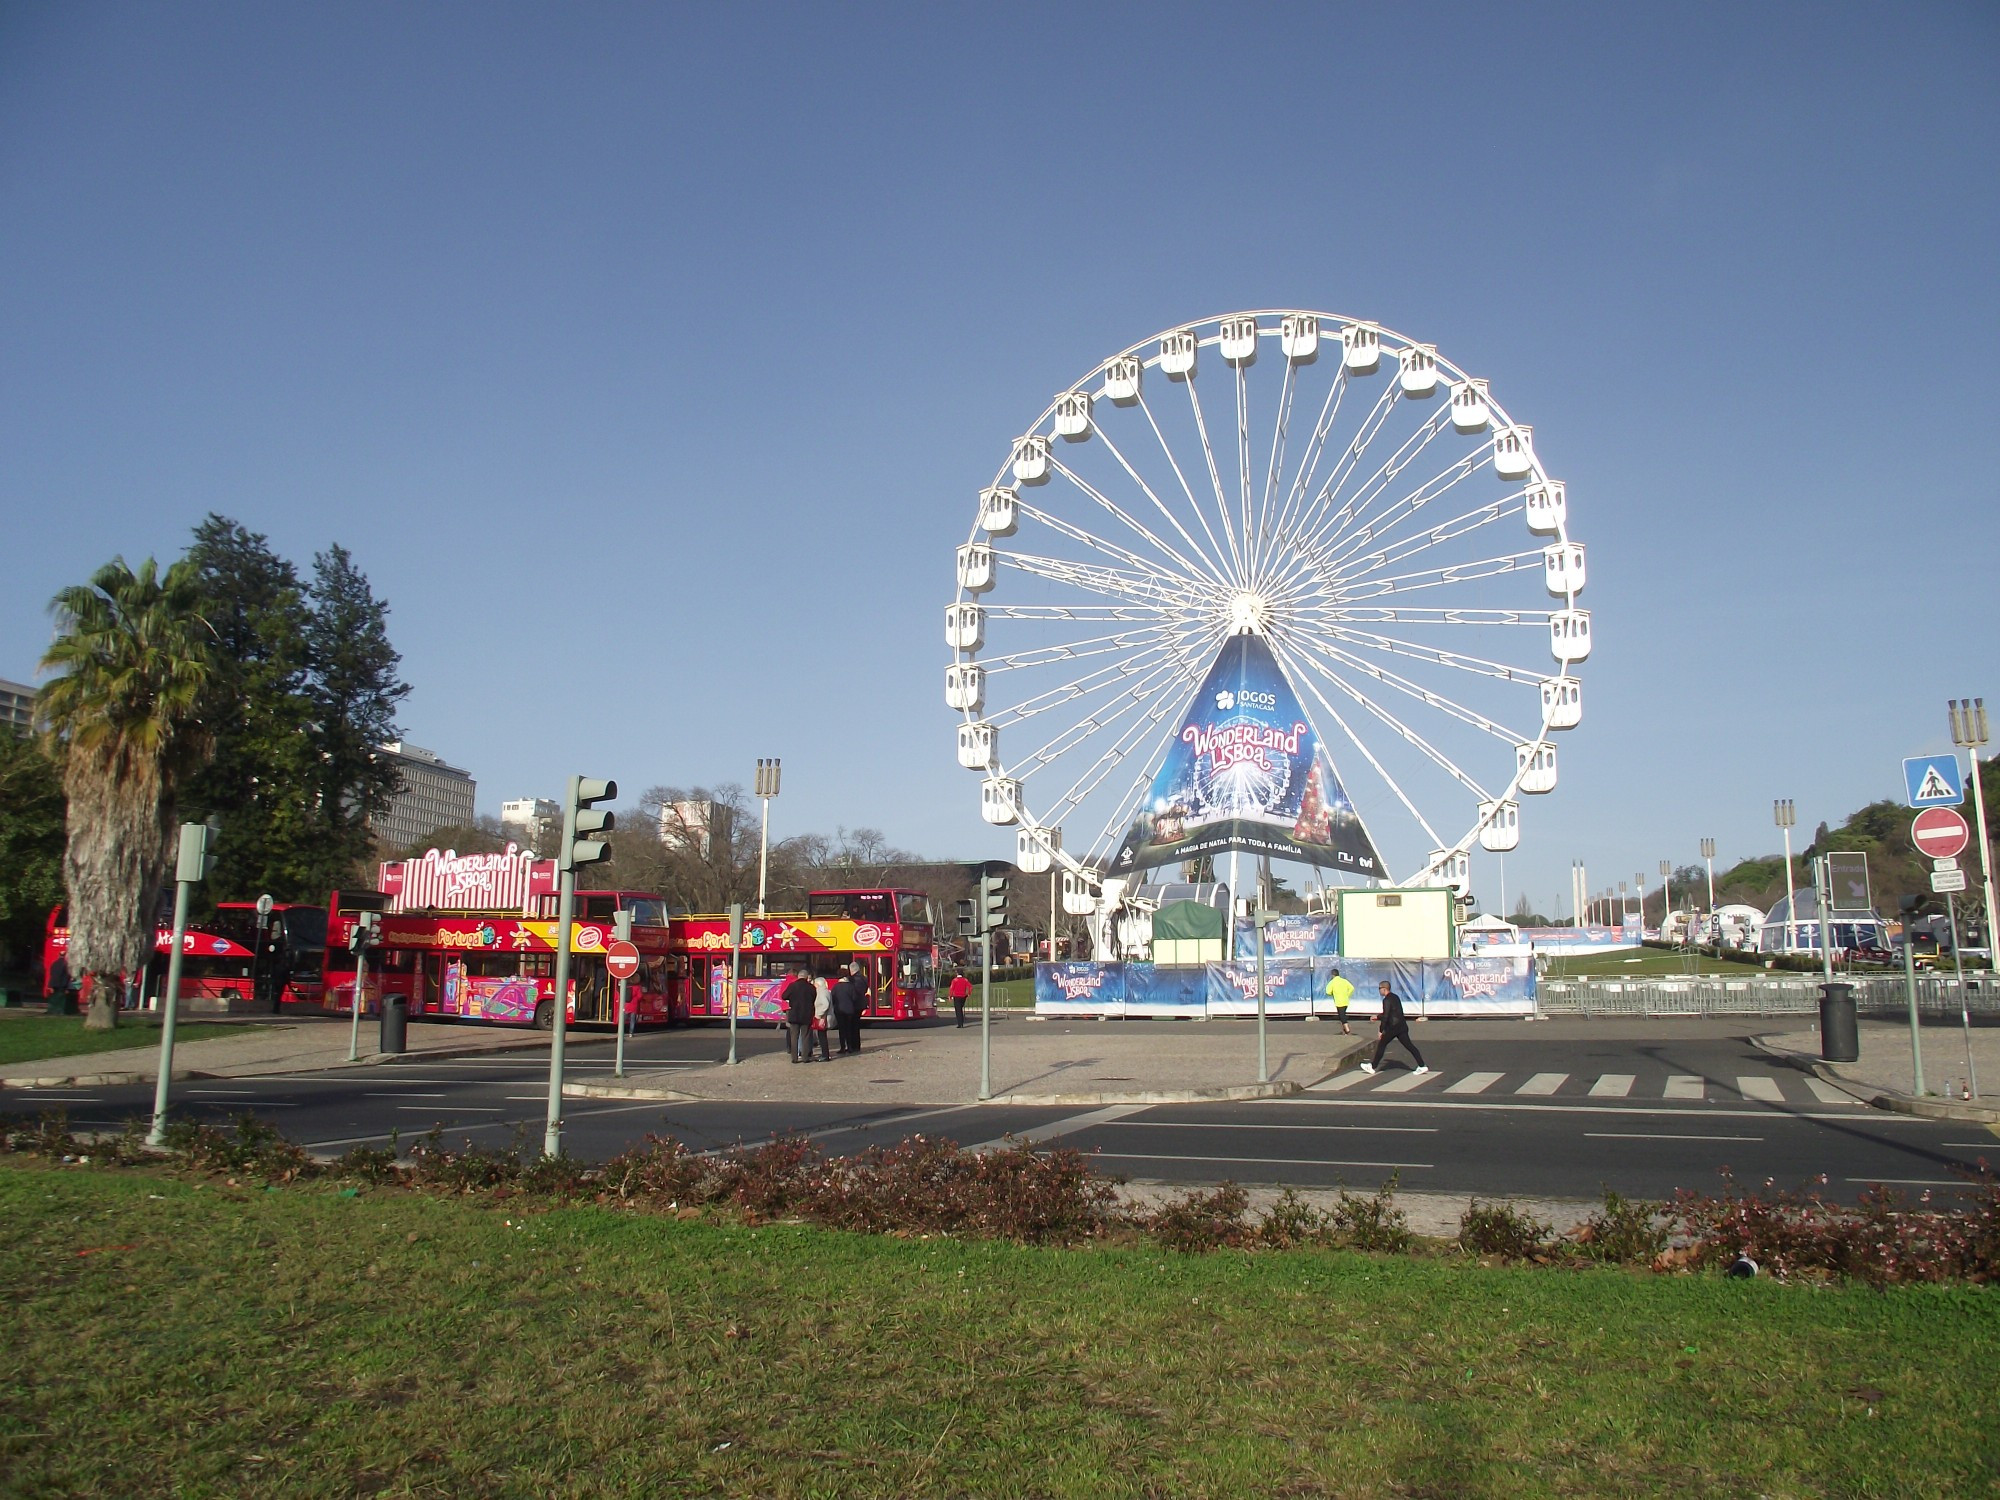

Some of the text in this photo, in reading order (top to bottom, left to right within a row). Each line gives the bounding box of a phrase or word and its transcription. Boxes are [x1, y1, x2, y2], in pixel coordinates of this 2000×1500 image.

[1236, 690, 1275, 705] JOGOS
[1180, 845, 1199, 854] MAGIA
[1200, 842, 1208, 850] DE
[1209, 838, 1227, 847] NATAL
[1228, 836, 1247, 845] PARA
[1248, 838, 1266, 848] TODA
[1273, 843, 1302, 855] FAMÍLIA
[1359, 856, 1373, 868] tvi
[1831, 864, 1865, 873] Entrada
[437, 928, 485, 949] Portugal
